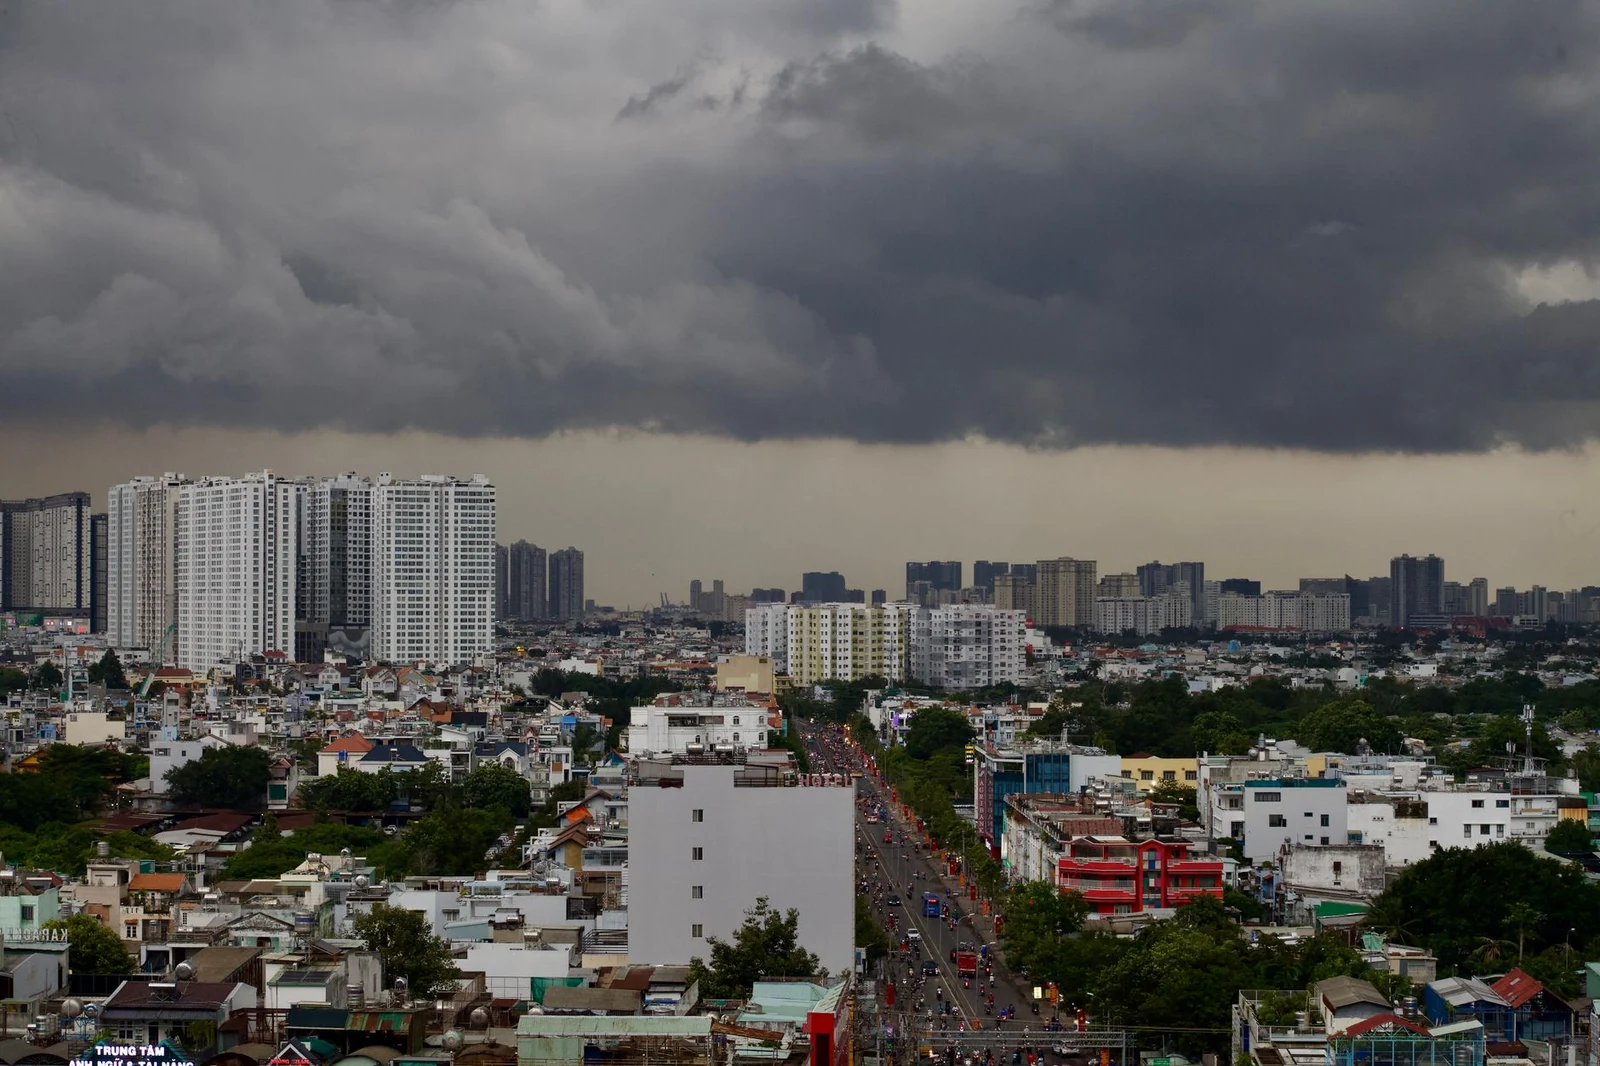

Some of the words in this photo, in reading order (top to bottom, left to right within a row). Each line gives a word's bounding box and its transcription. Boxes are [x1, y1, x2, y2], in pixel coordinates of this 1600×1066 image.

[799, 773, 853, 787] HOTEL
[95, 1046, 137, 1056] TRUNG
[139, 1044, 165, 1056] TÂM
